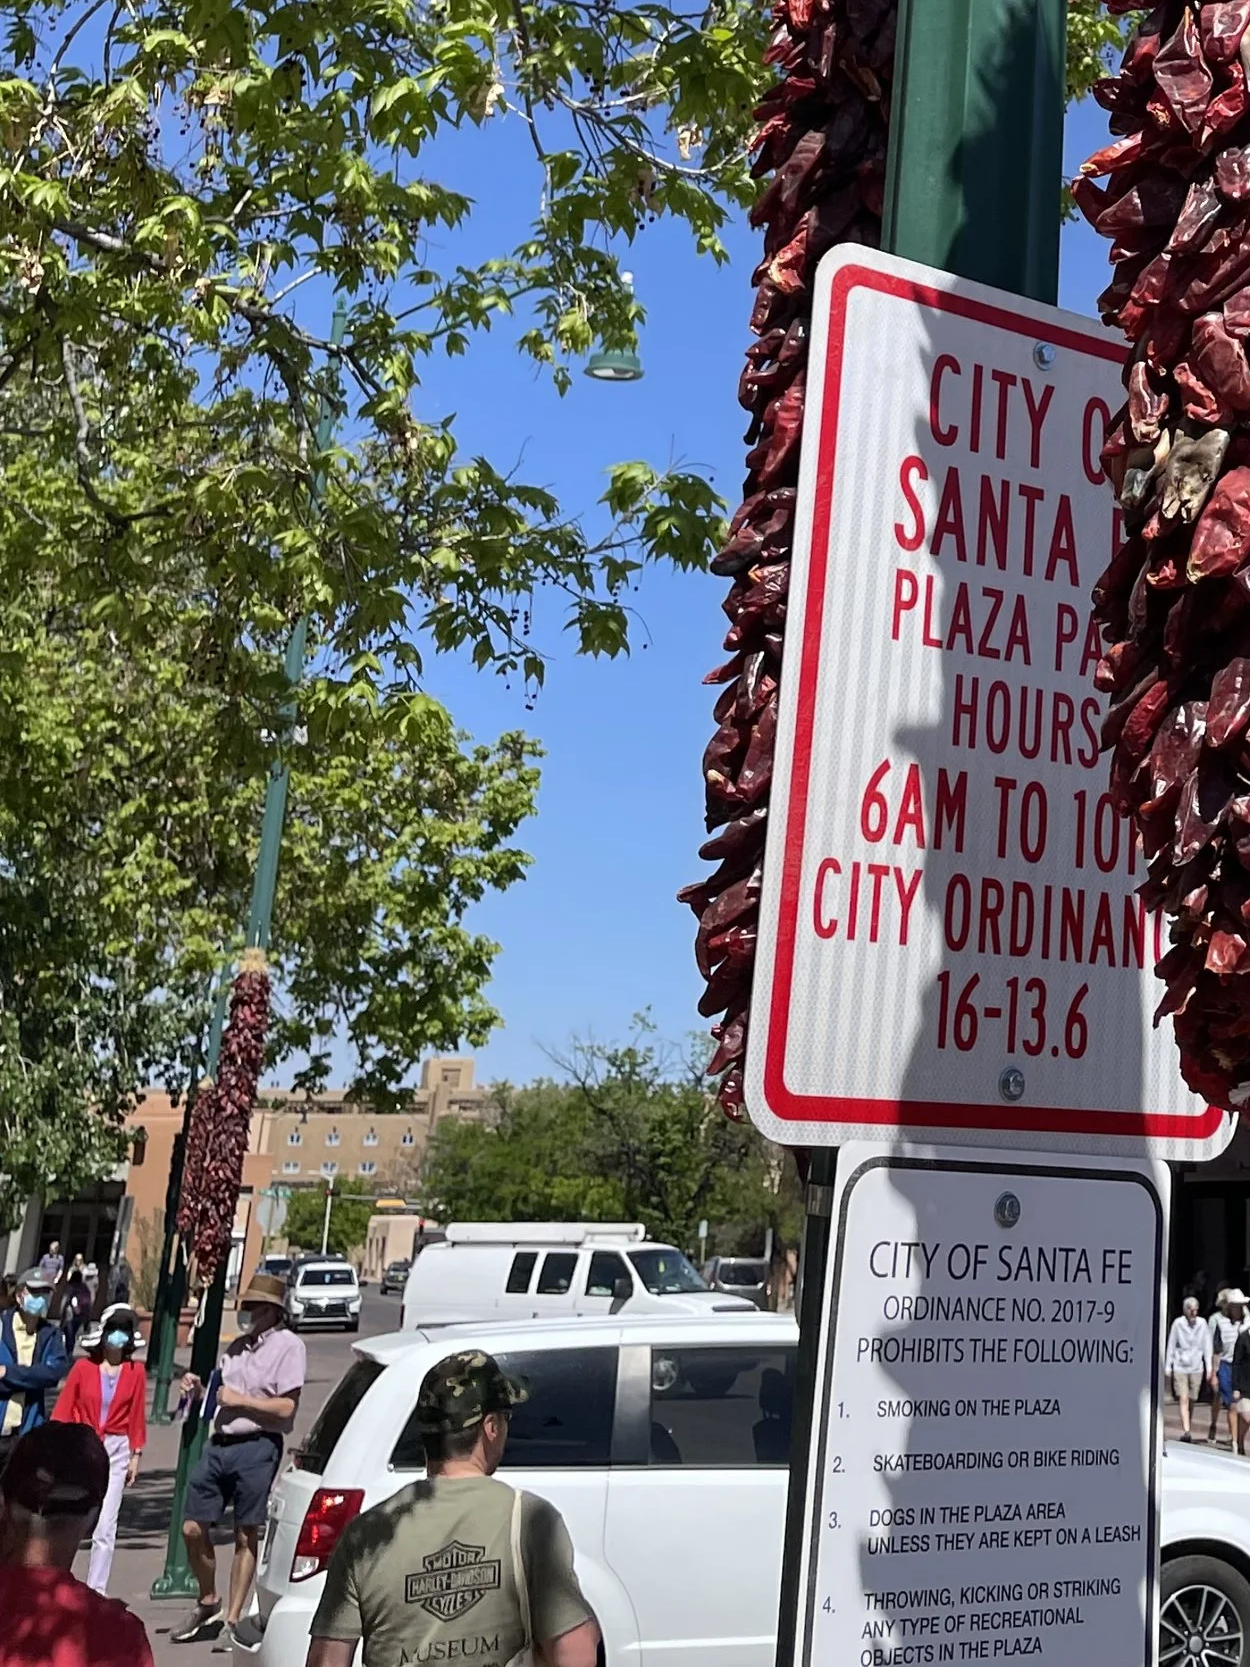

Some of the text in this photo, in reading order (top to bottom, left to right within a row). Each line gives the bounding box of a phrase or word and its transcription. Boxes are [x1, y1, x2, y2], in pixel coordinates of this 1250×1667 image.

[929, 353, 1111, 486] CITY O
[894, 455, 1080, 587] SANTA
[891, 568, 1032, 666] PLAZA
[952, 674, 1101, 769] HOURS
[860, 758, 1137, 876] 6AM TO 10
[813, 857, 1163, 970] CITY ORDINAN
[936, 970, 1090, 1060] 16-13.6
[869, 1240, 1133, 1285] CITY OF SANTA FE
[883, 1294, 1115, 1324] ORDINANCE NO. 2017-9
[856, 1337, 1134, 1363] PROHIBITS THE FOLLOWING:
[837, 1398, 1061, 1419] 1. SMOKING ON THE PLAZA
[833, 1449, 1120, 1473] 2. SKATEBOARDING OR BIKE RIDING
[828, 1502, 1066, 1529] 3. DOGS IN THE PLAZA AREA
[867, 1525, 1142, 1555] UNLESS THEY ARE KEPT ON A LEASH
[822, 1578, 1121, 1614] 4. THROWING, KICKING OR STRIKING
[861, 1607, 1084, 1640] ANY TYPE OF RECREATIONAL
[399, 1633, 499, 1667] MUSEUM
[860, 1636, 1043, 1667] OBJECTS IN THE PLAZA
